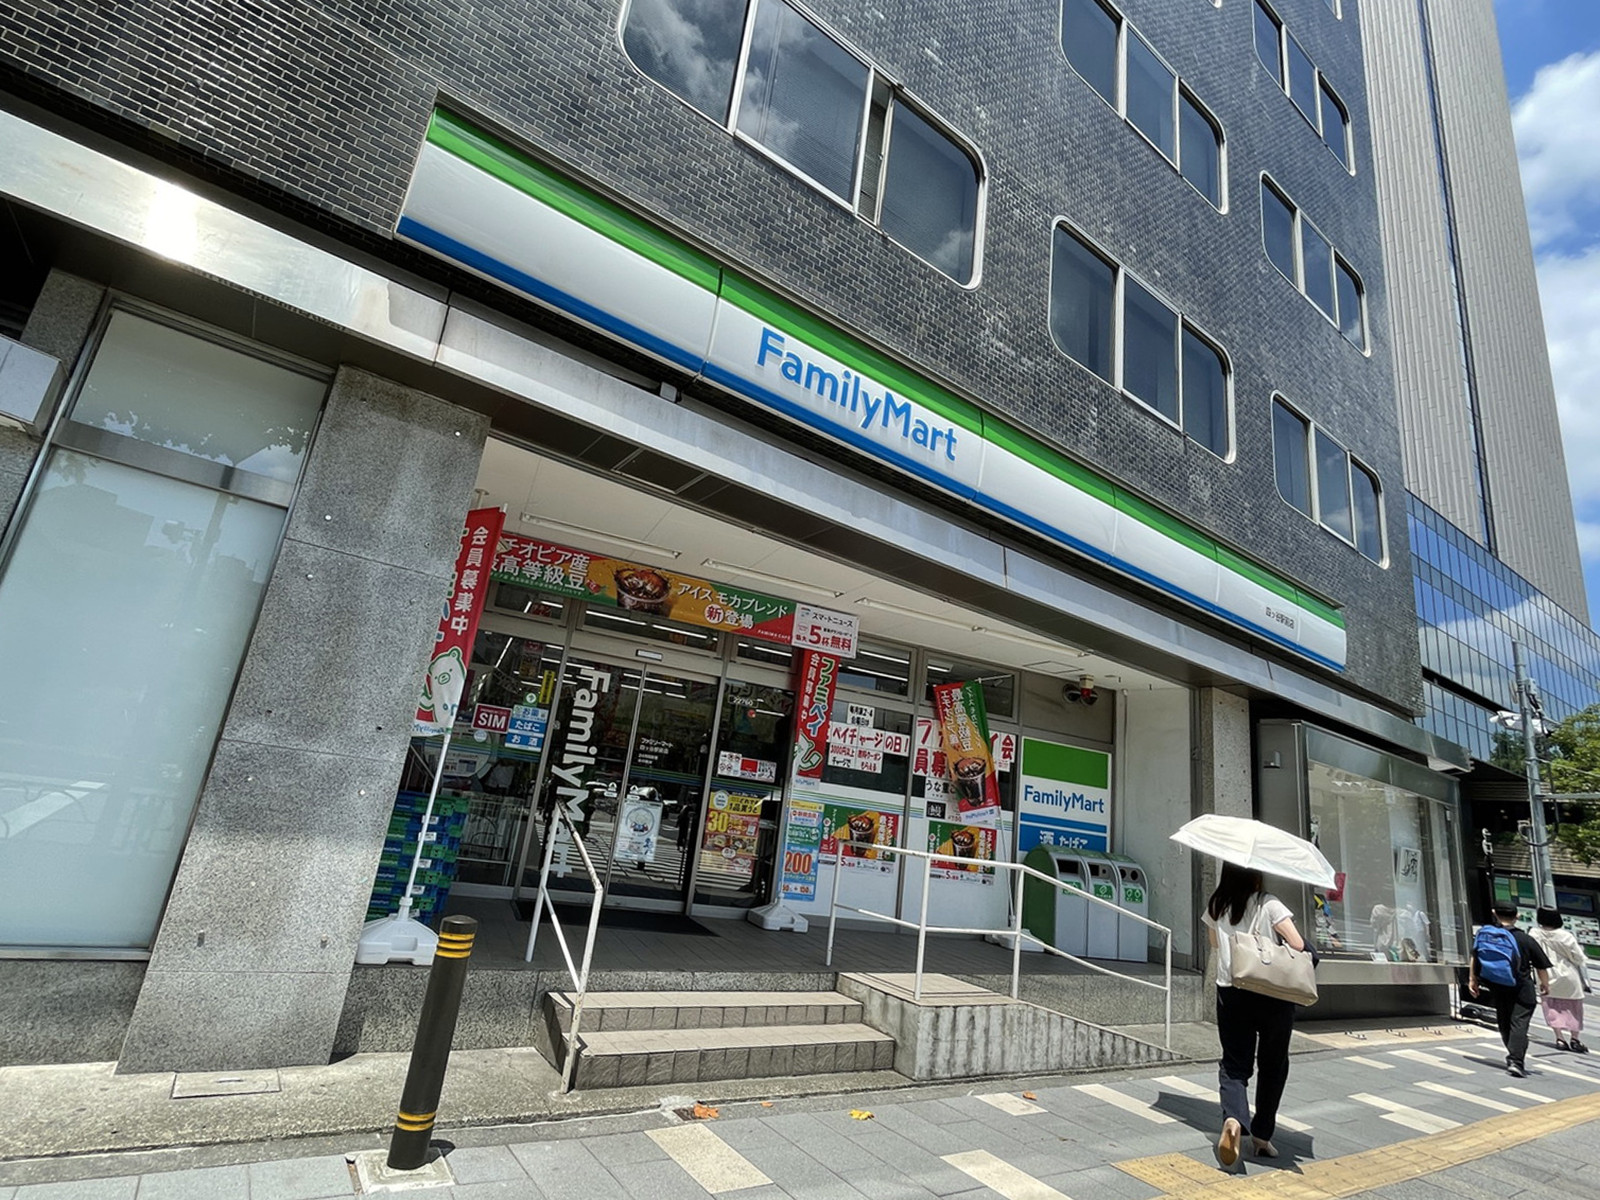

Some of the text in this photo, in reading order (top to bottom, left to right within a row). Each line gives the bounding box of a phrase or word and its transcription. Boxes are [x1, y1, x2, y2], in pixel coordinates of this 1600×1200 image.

[757, 327, 957, 461] FamilyMart
[504, 537, 590, 577] チオピア産
[677, 582, 789, 618] アイス モカブレンド
[706, 605, 754, 630] 新登場
[812, 612, 853, 628] スマートニュース
[806, 656, 836, 738] ファミペイ
[478, 712, 506, 729] SIM
[514, 720, 540, 732] たばこ
[829, 726, 910, 754] ペイチャージの日！
[549, 668, 612, 878] FamilyMart
[913, 747, 952, 779] 員募
[1024, 784, 1105, 814] FamilyMart
[707, 810, 729, 833] 30
[1039, 830, 1055, 846] 酒
[784, 850, 812, 875] 200
